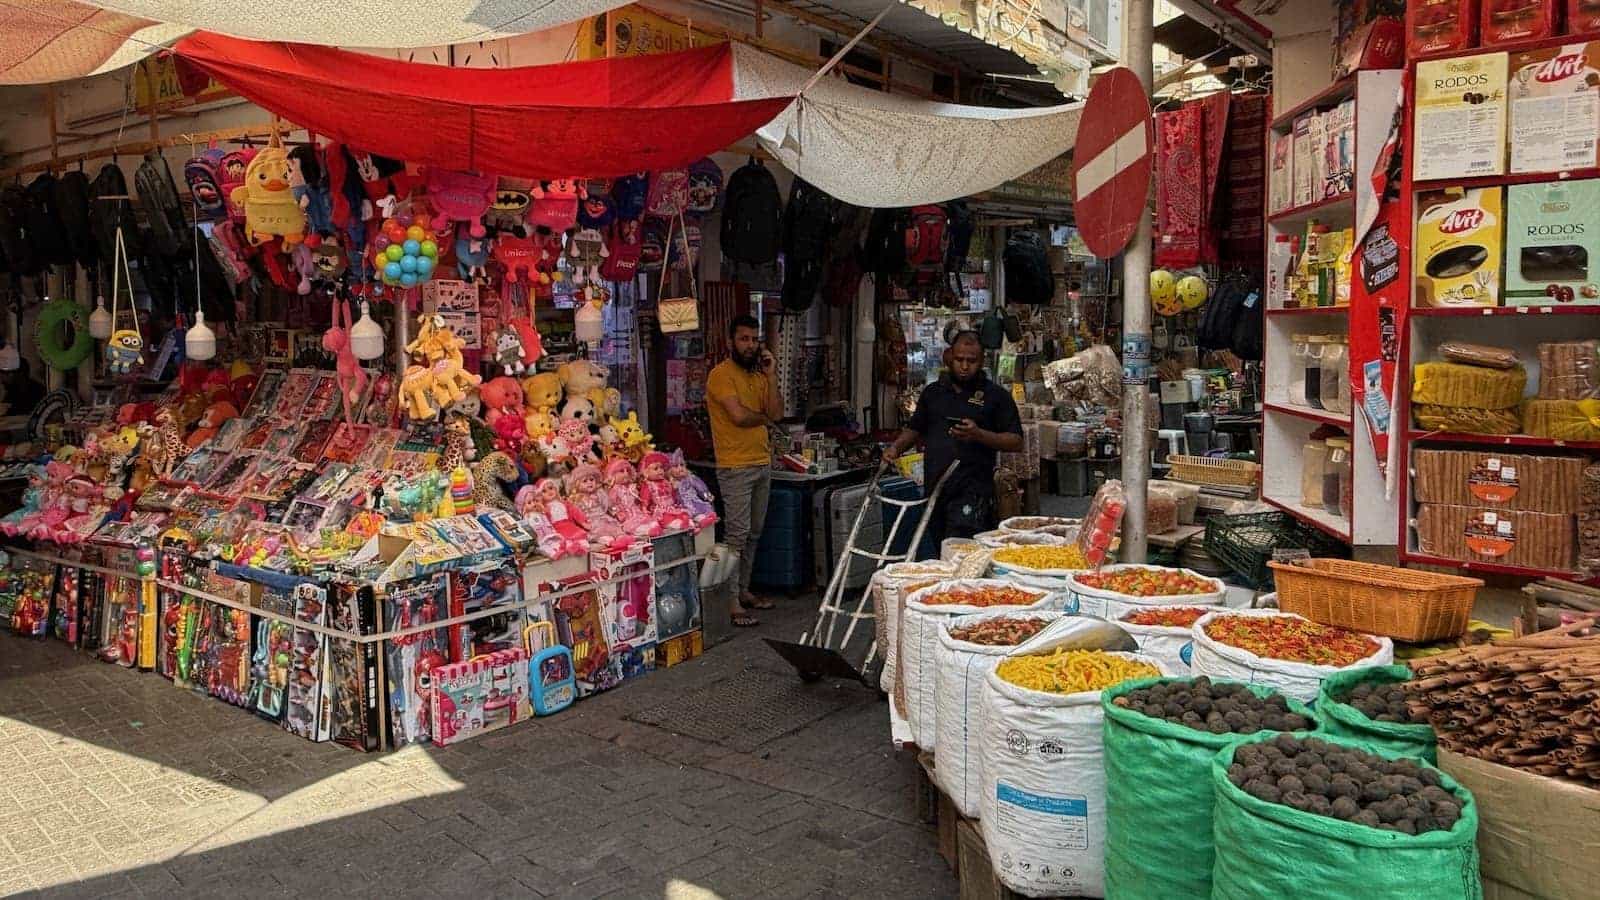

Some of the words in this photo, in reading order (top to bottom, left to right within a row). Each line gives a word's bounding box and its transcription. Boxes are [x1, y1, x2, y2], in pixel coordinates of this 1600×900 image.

[1538, 55, 1584, 79] Avit
[1434, 73, 1488, 89] RODOS
[1441, 208, 1481, 229] Avit
[1527, 224, 1585, 236] RODOS
